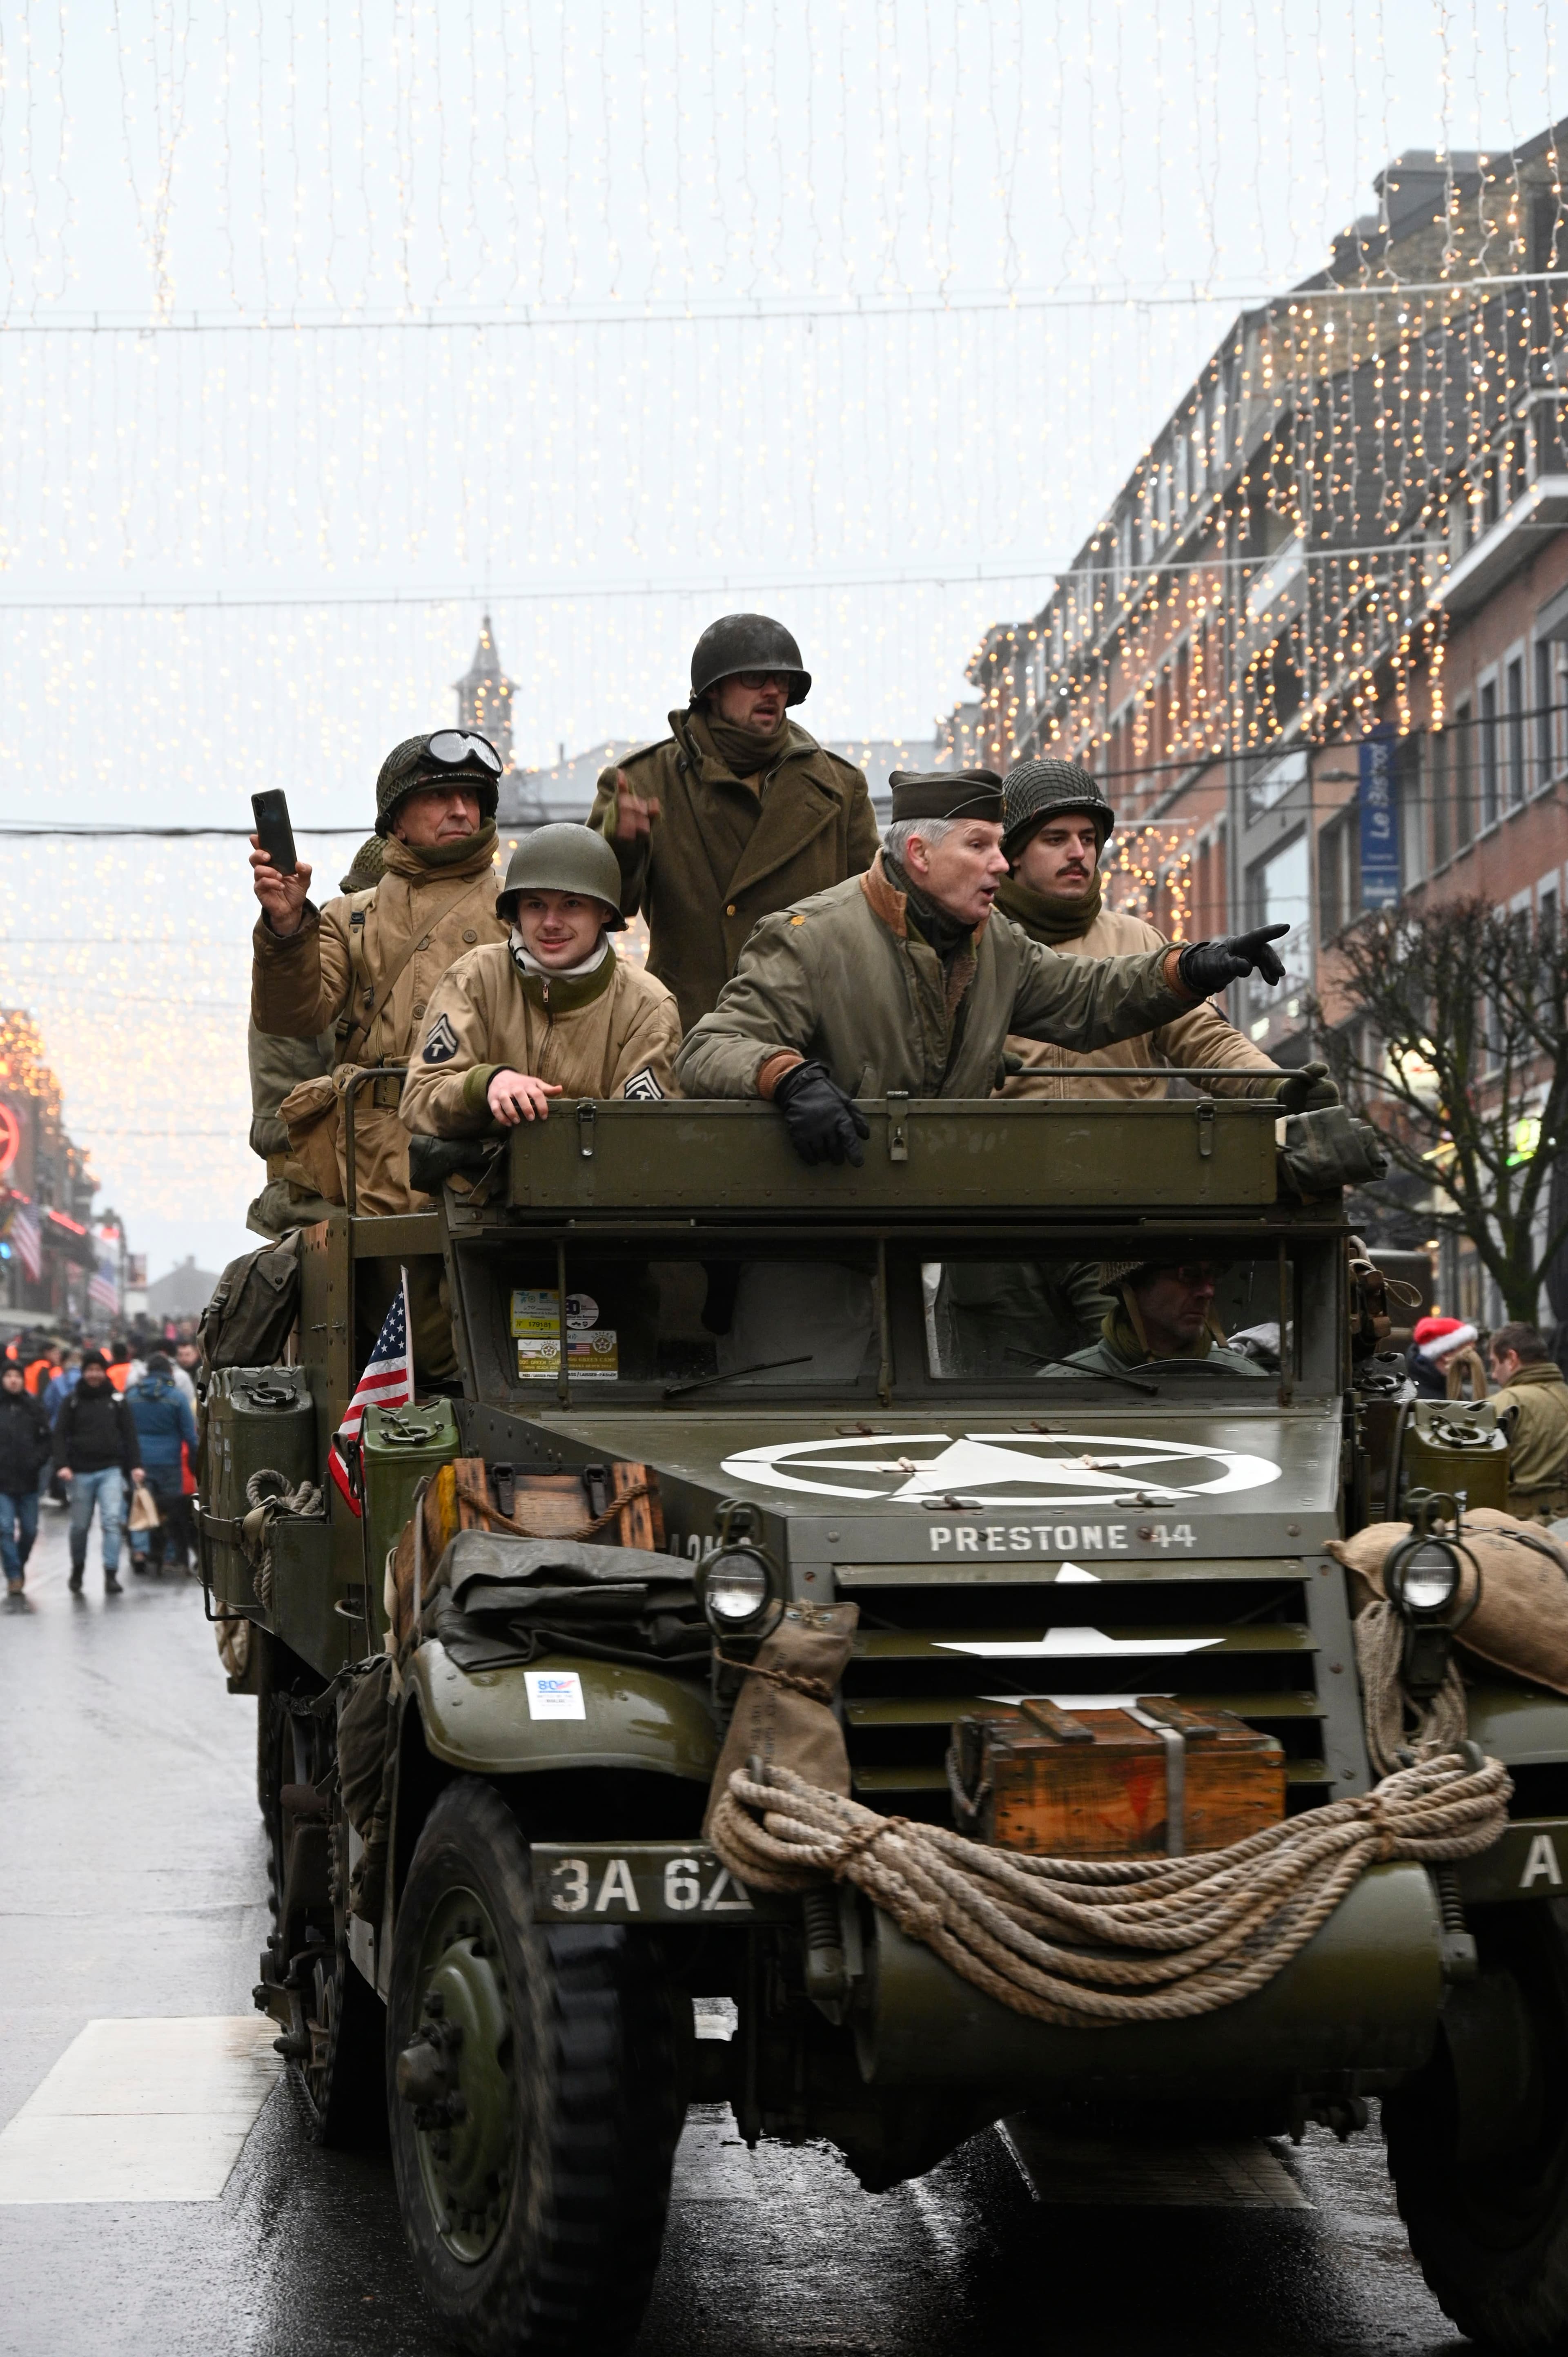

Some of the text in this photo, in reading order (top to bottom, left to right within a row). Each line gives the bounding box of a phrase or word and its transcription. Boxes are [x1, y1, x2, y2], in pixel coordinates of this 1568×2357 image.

[431, 1044, 444, 1057] T
[929, 1524, 1198, 1551] PRESTONE 44
